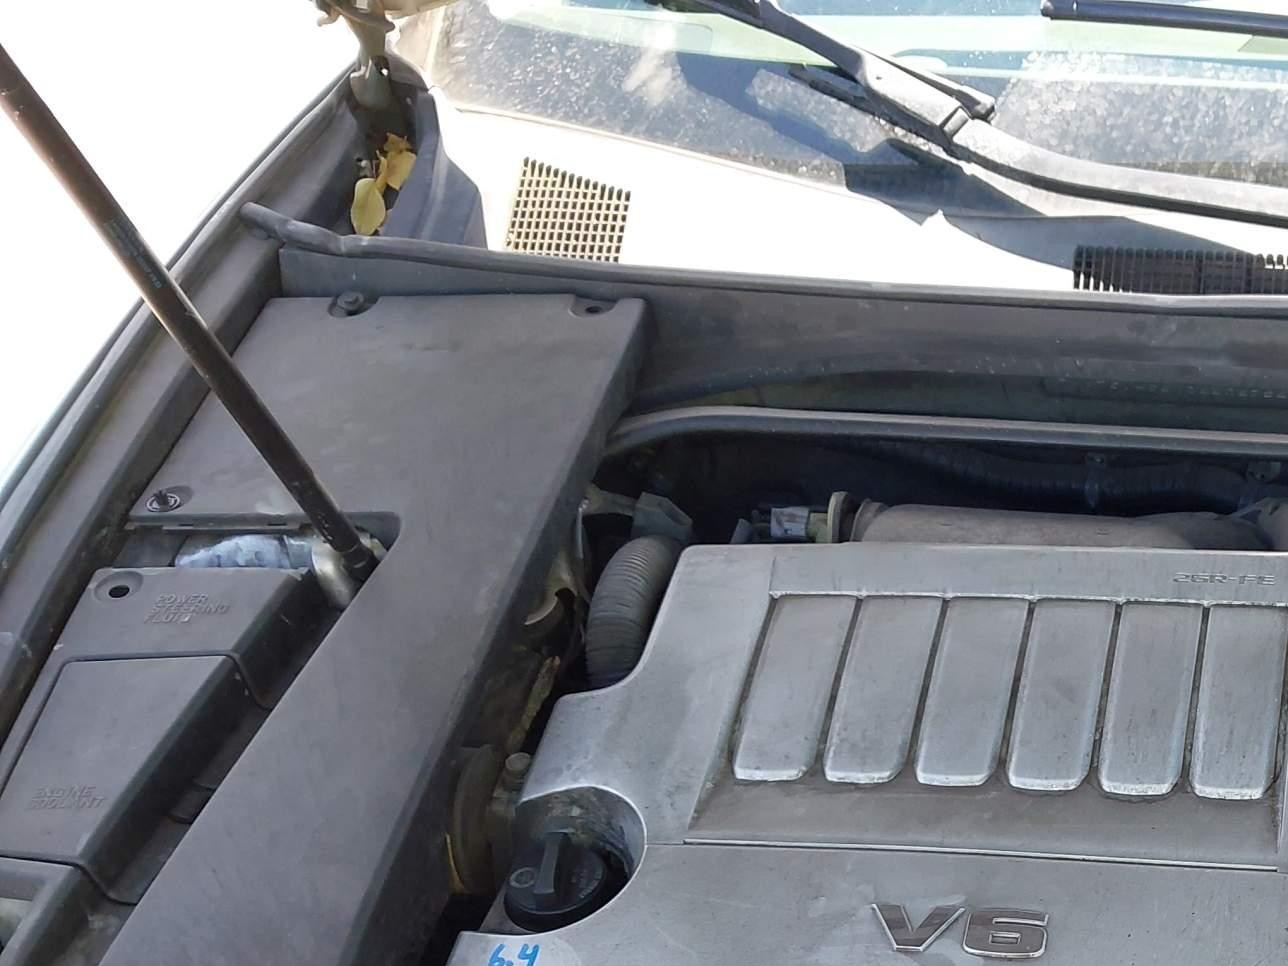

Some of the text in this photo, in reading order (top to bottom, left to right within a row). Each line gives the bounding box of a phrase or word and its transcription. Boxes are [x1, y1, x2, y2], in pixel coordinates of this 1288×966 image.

[156, 592, 208, 604] POWER
[150, 603, 230, 615] STEERING
[871, 903, 1049, 959] V6
